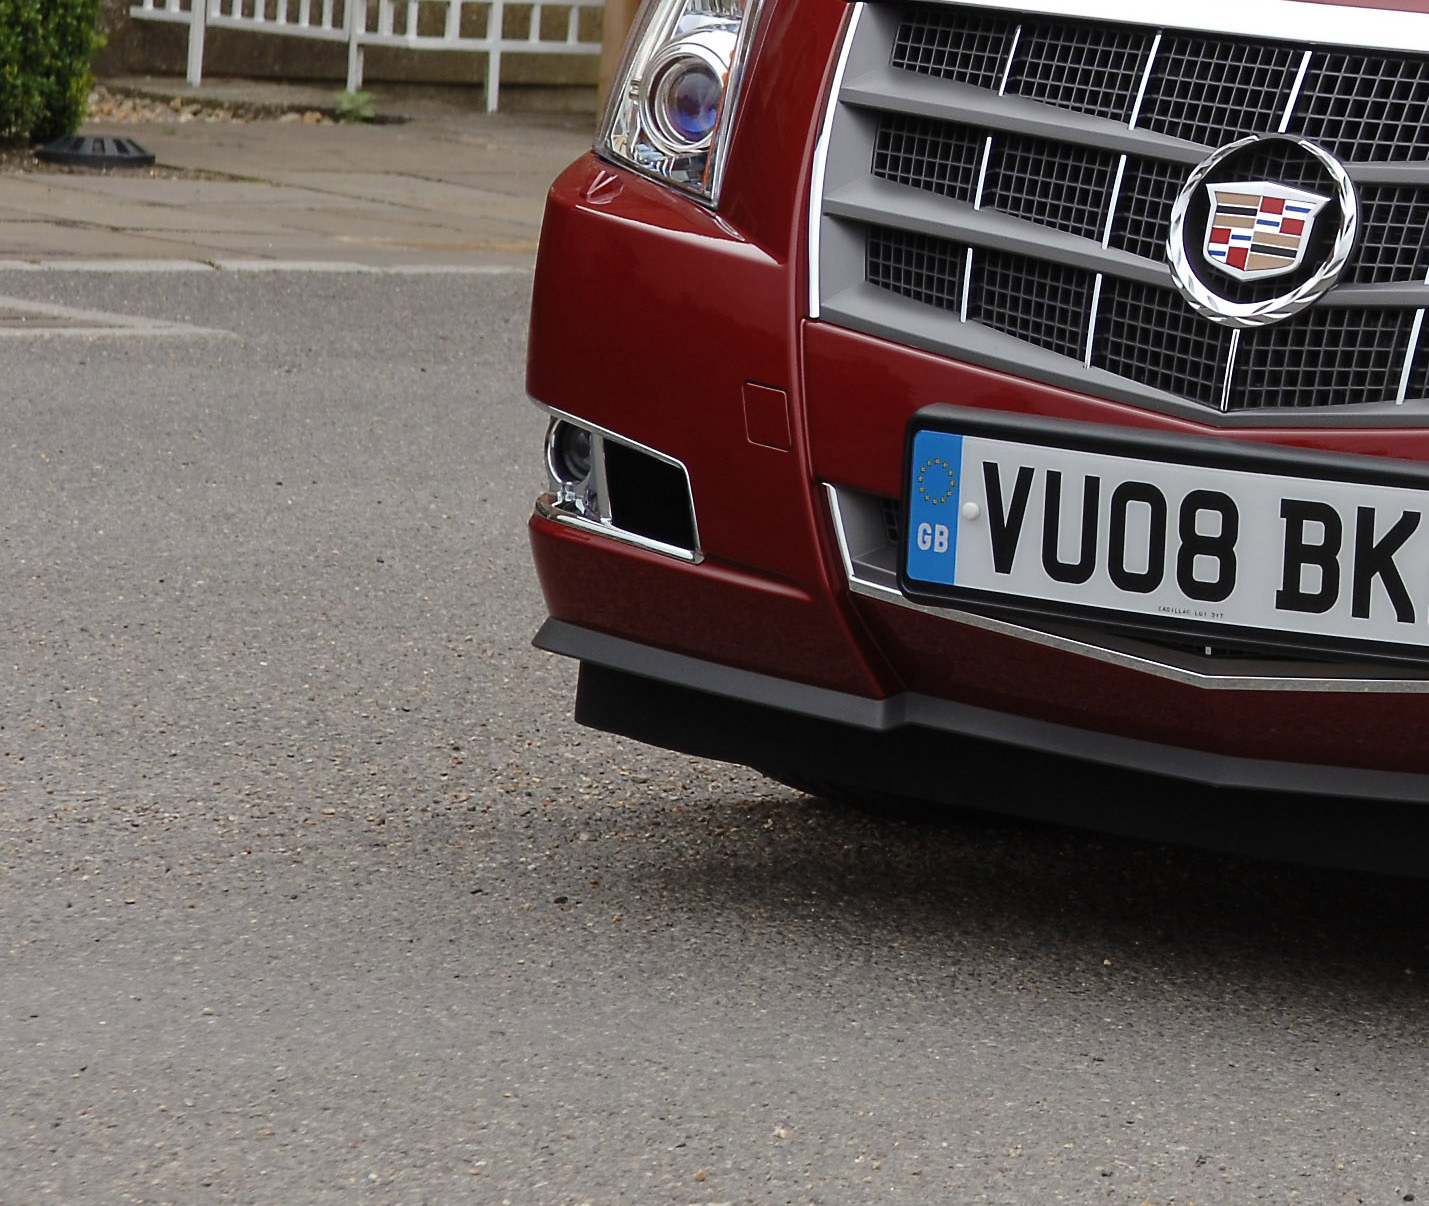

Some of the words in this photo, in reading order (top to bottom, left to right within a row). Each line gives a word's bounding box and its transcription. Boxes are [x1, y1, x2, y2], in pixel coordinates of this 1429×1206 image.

[917, 522, 949, 553] GB
[982, 460, 1239, 603] VU08
[1158, 605, 1190, 615] CADILLAC
